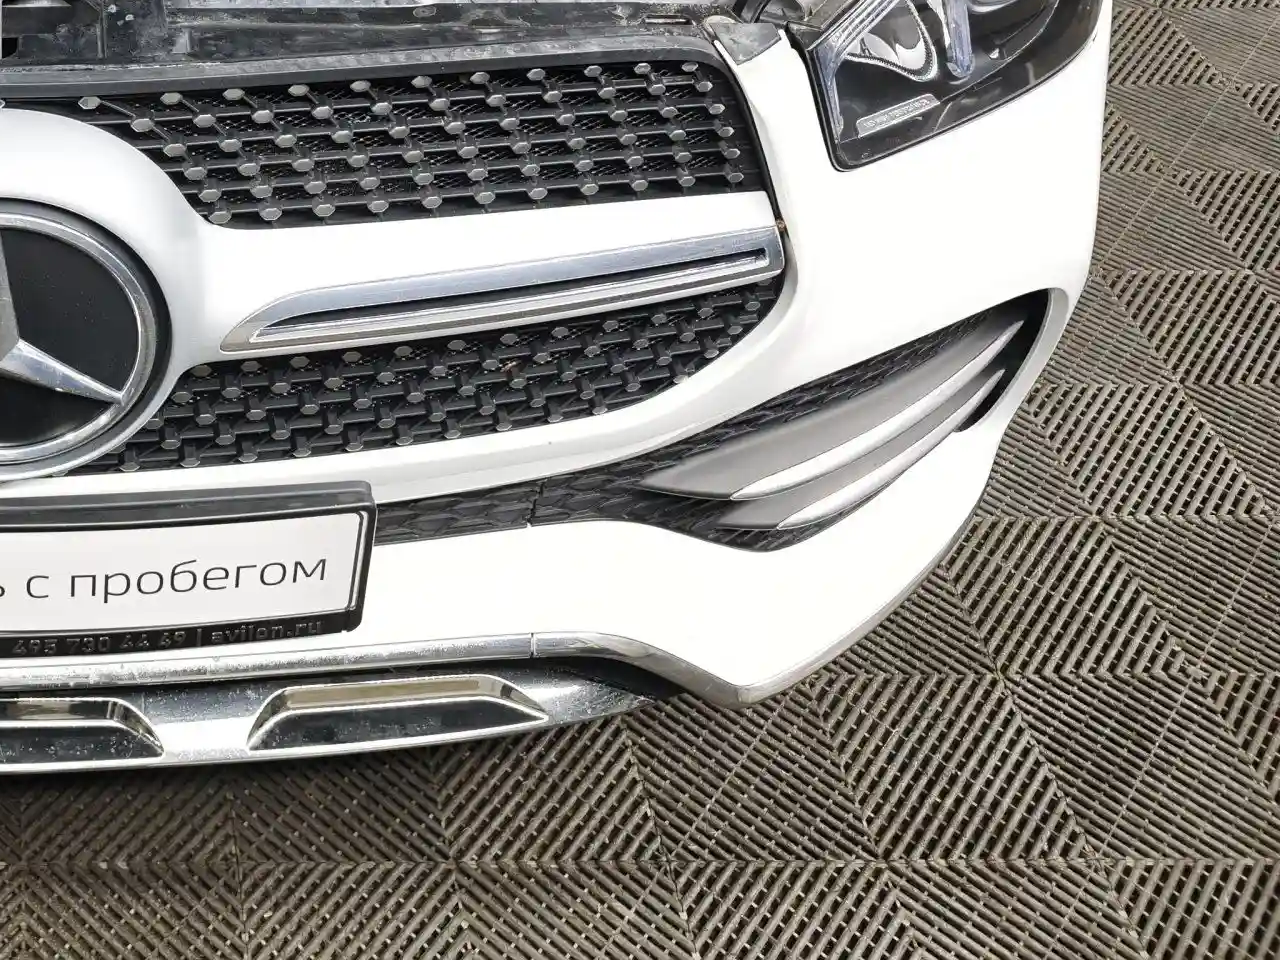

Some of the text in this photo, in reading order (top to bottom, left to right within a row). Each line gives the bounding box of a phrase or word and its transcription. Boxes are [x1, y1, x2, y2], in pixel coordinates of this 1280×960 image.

[26, 574, 50, 599] с
[70, 558, 327, 604] пробегом
[66, 636, 111, 654] 730
